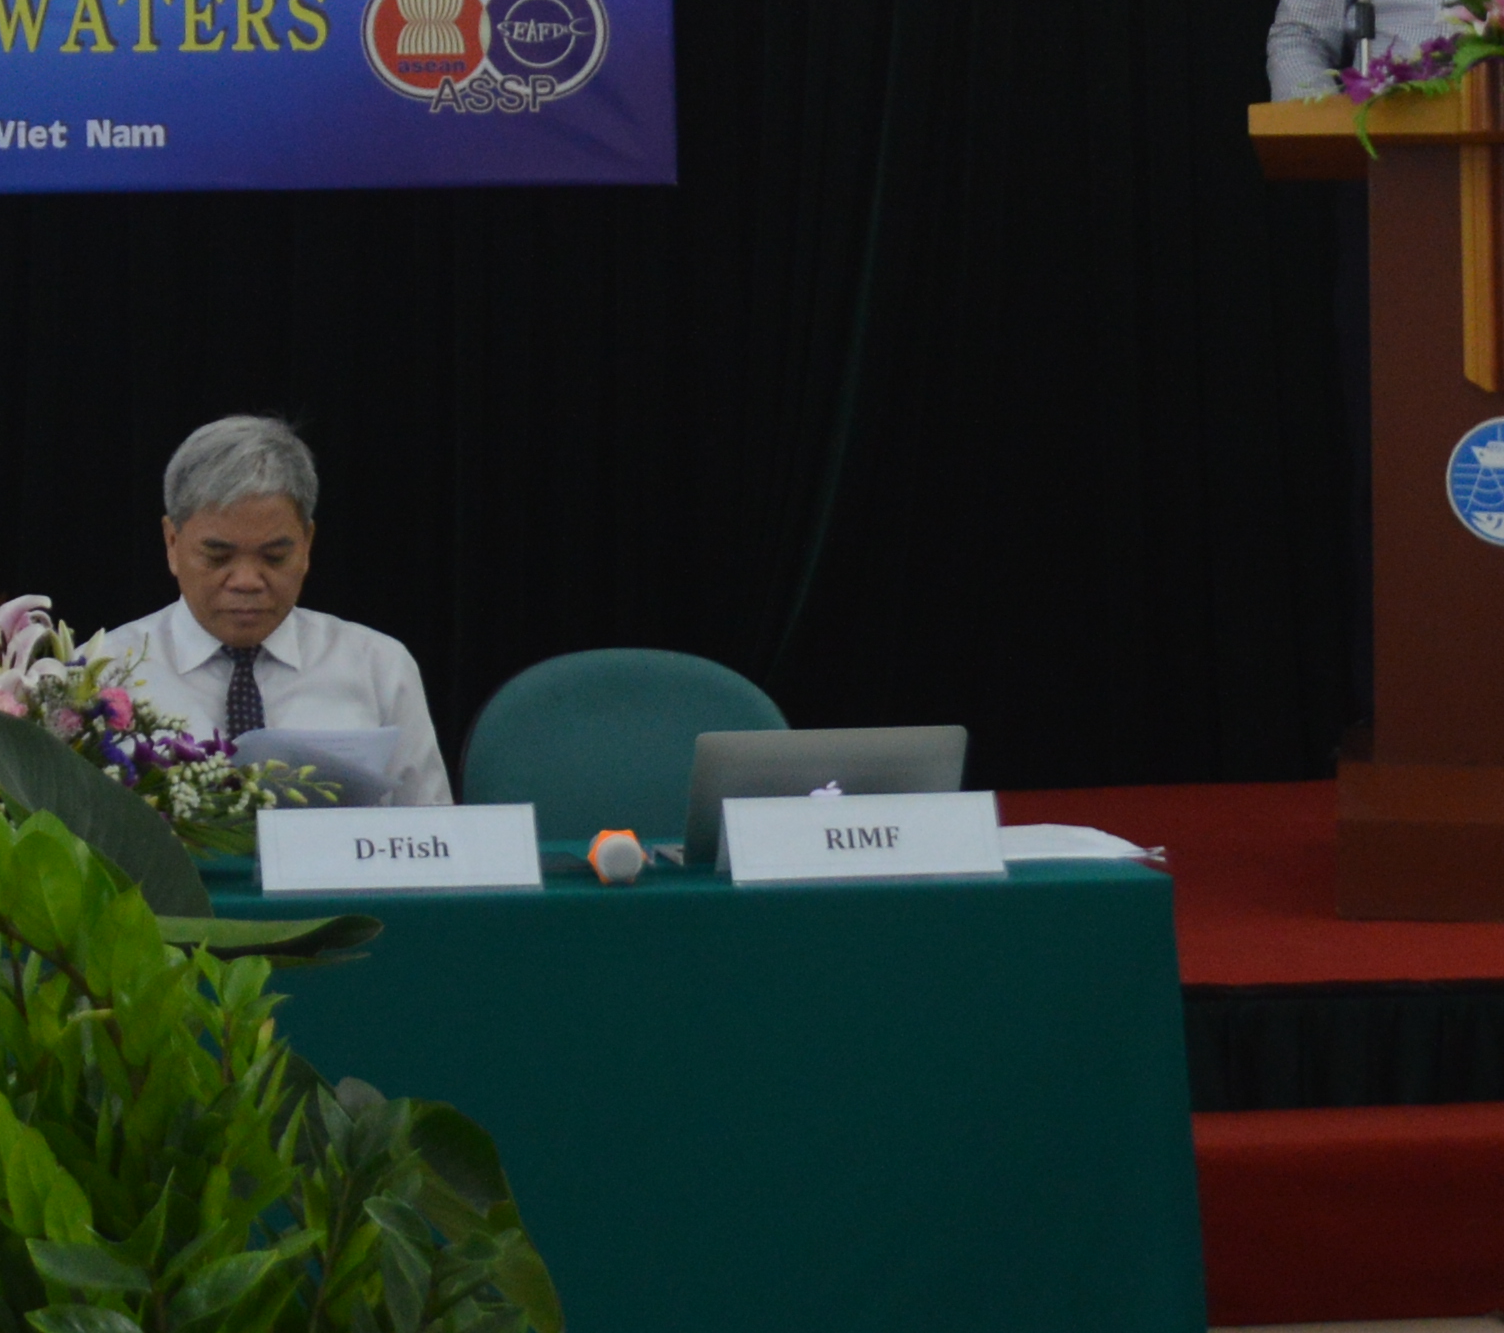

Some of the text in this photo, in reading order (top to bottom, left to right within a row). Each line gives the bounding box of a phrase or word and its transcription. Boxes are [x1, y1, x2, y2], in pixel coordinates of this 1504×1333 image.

[397, 59, 467, 74] asean
[429, 75, 558, 114] ASSP
[87, 120, 165, 147] Nam
[356, 836, 449, 860] D-Fish
[826, 827, 897, 849] RIMF
